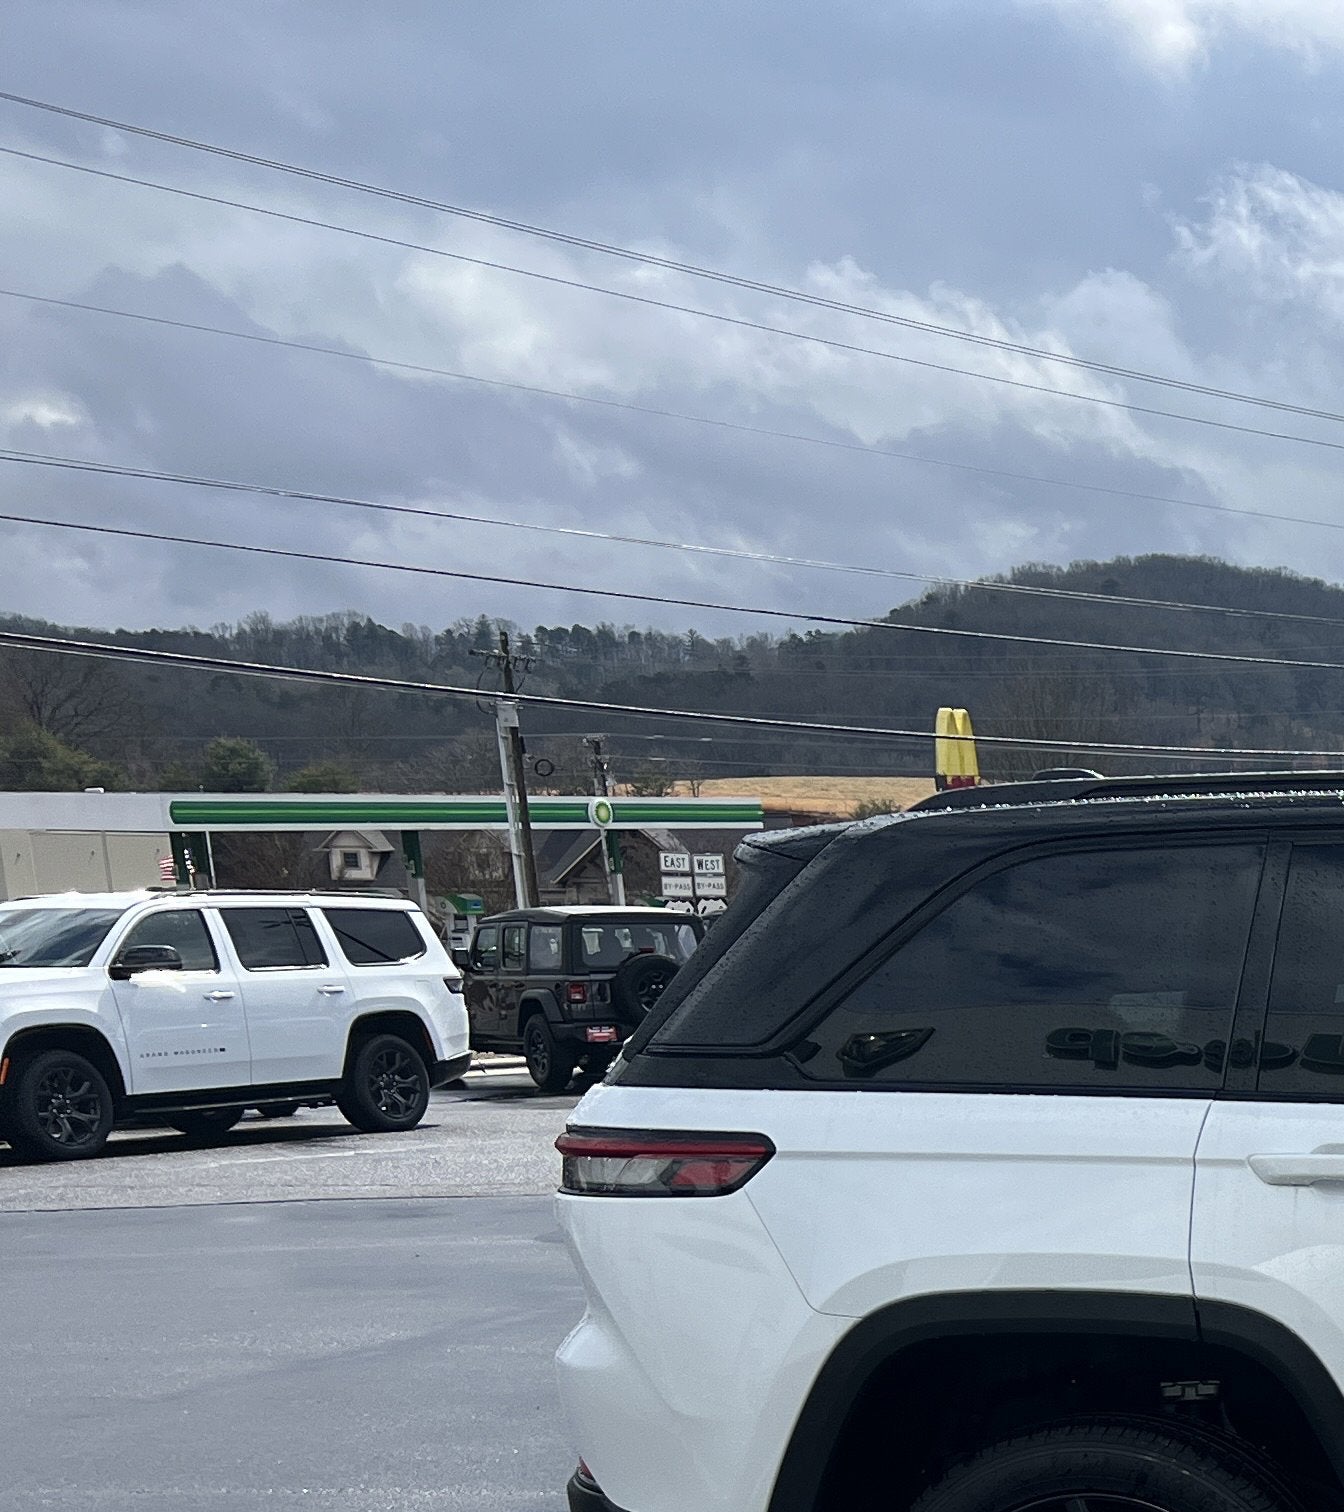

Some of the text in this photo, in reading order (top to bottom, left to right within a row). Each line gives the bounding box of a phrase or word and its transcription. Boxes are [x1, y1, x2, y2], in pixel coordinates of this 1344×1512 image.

[664, 856, 686, 868] EAST
[697, 859, 720, 871] WEST
[697, 882, 724, 890] BY-PASS
